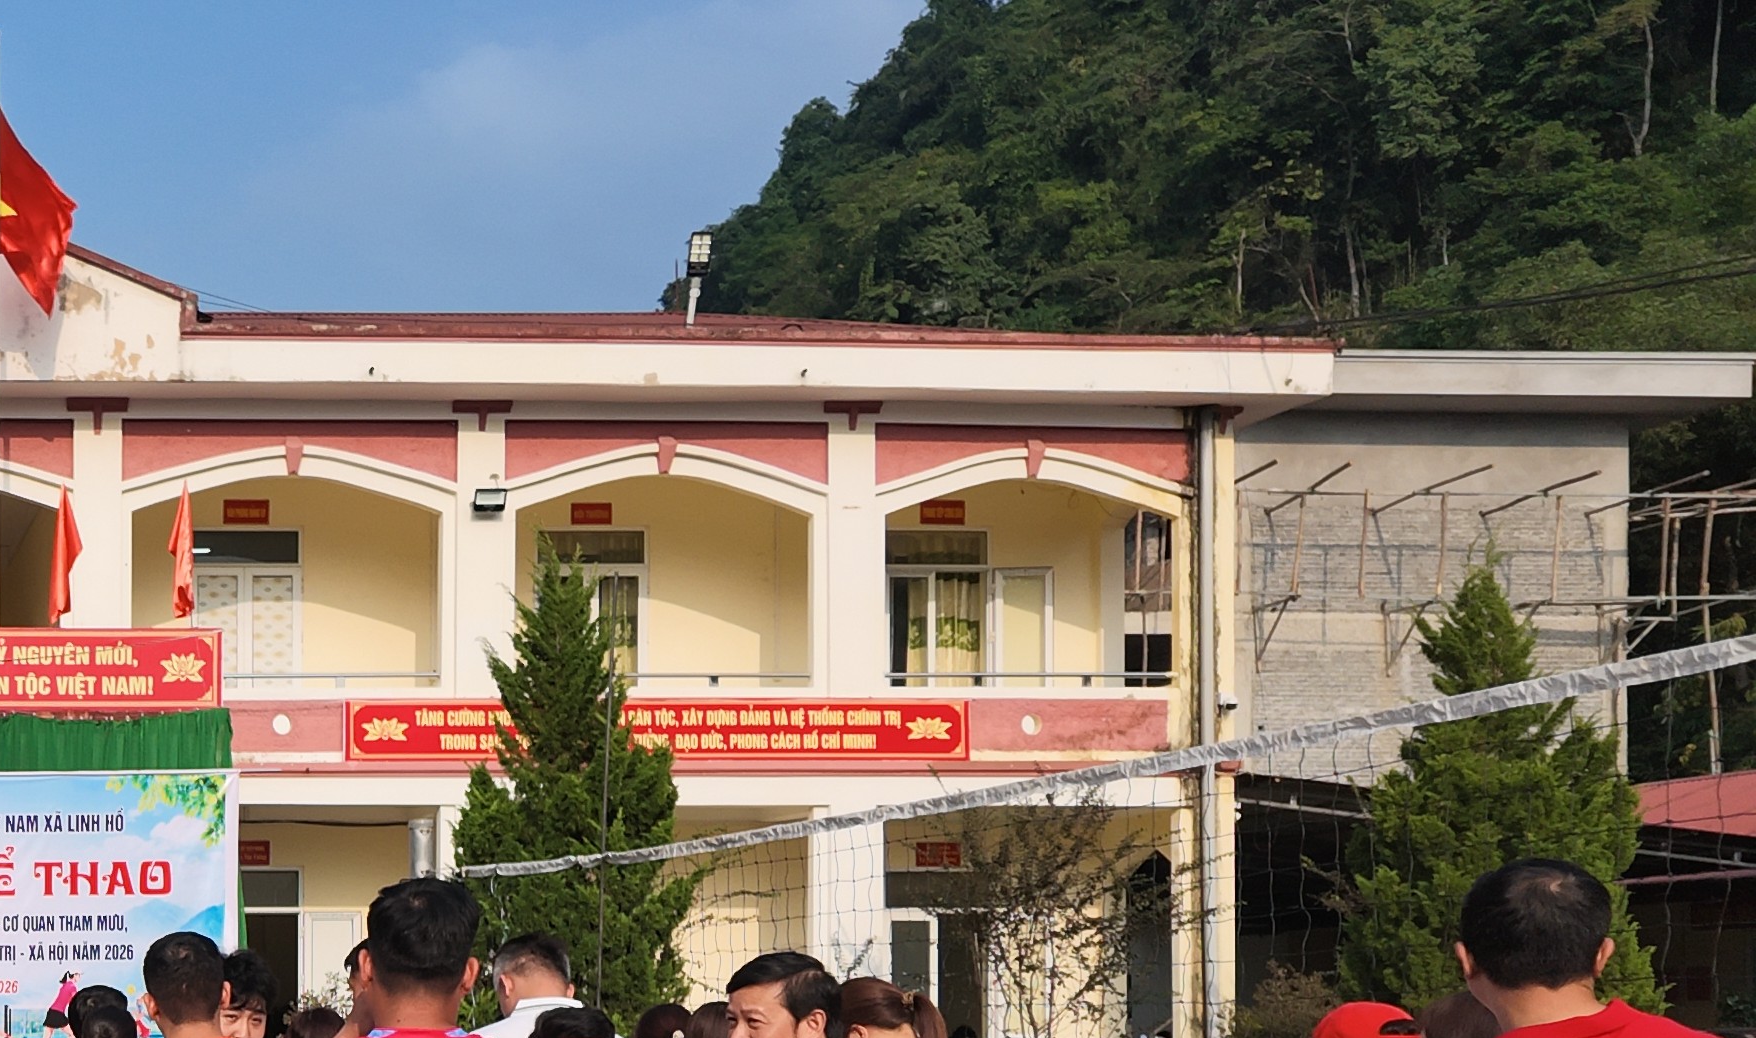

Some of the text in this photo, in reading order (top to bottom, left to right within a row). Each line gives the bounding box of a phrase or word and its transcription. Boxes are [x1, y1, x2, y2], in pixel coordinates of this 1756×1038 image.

[12, 642, 90, 666] NGUYÊN
[95, 641, 139, 668] MỚI,
[14, 672, 51, 699] TỘC
[56, 672, 96, 699] VIỆT
[101, 676, 154, 696] NAM!
[447, 706, 486, 727] CƯỜNG
[654, 708, 679, 728] TỘC,
[681, 707, 704, 726] XÂY
[706, 708, 737, 728] DỰNG
[740, 704, 771, 726] ĐẢNG
[773, 707, 788, 726] VÀ
[791, 708, 805, 729] HỆ
[808, 706, 844, 726] THỐNG
[847, 707, 881, 726] CHÍNH
[884, 709, 901, 729] TRỊ
[439, 734, 477, 750] TRONG
[675, 734, 698, 752] ĐẠO
[701, 730, 727, 750] ĐỨC,
[730, 733, 768, 749] PHONG
[771, 732, 800, 749] CÁCH
[803, 730, 818, 749] HỒ
[821, 731, 840, 749] CHÍ
[843, 734, 876, 749] MINH!
[5, 815, 39, 833] NAM
[44, 811, 63, 833] XÃ
[67, 815, 100, 832] LINH
[105, 808, 124, 832] HỒ
[34, 861, 173, 896] THAO
[3, 914, 19, 932] CƠ
[23, 916, 55, 933] QUAN
[59, 915, 92, 932] THAM
[97, 914, 128, 933] MƯU,
[29, 942, 45, 961] XÃ
[49, 941, 69, 964] HỘI
[72, 941, 101, 960] NĂM
[104, 944, 134, 961] 2026
